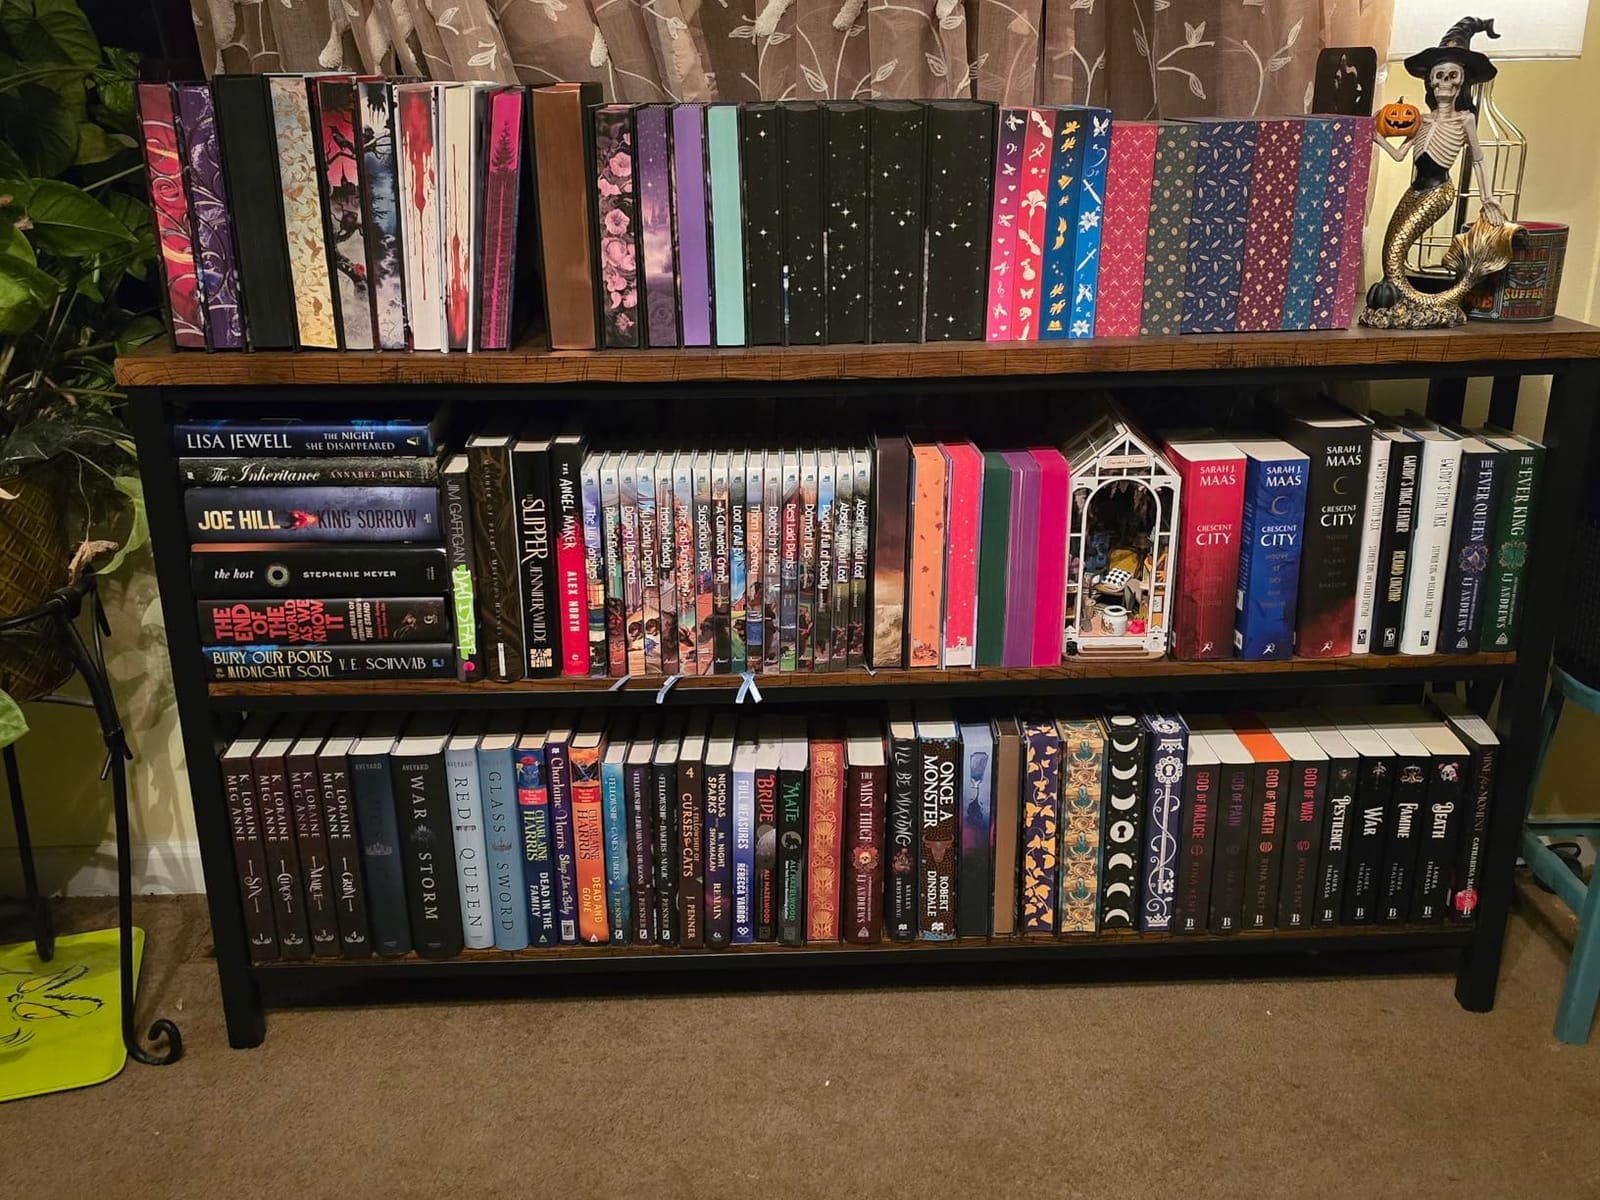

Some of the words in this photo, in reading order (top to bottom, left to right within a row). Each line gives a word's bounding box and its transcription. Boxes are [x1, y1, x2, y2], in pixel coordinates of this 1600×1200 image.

[186, 434, 224, 448] LISA
[230, 434, 292, 448] JEWELL
[306, 442, 324, 450] SHE
[326, 442, 395, 450] DISAPPEARED
[341, 432, 375, 440] NIGHT
[1327, 446, 1352, 454] SARAH
[206, 469, 228, 482] The
[232, 464, 320, 482] Inheritance
[1200, 465, 1225, 475] SARAH
[1266, 466, 1291, 476] SARAH
[1326, 454, 1362, 467] MAAS
[445, 480, 460, 499] JIM
[1200, 474, 1236, 486] MAAS
[1266, 474, 1301, 487] MAAS
[1476, 469, 1492, 500] EVER
[1513, 468, 1533, 504] EVER
[559, 478, 575, 512] ANGEL
[1321, 505, 1356, 513] CRESCENT
[198, 511, 233, 530] JOE
[238, 511, 280, 530] HILL
[318, 511, 351, 528] KING
[358, 510, 416, 528] SORROW
[585, 509, 595, 524] The
[661, 507, 671, 536] Herbal
[733, 506, 743, 525] Loot
[768, 506, 778, 536] Rooted
[786, 504, 795, 521] Best
[804, 504, 815, 540] Dormant
[838, 502, 849, 532] Absent
[855, 499, 866, 528] Absent
[1320, 512, 1356, 526] CITY
[1470, 504, 1488, 540] QUEEN
[1510, 507, 1528, 536] KING
[448, 504, 464, 562] GAFFIGAN
[520, 499, 548, 565] SLIPPER
[562, 515, 576, 550] MAKER
[697, 505, 709, 550] Suspicious
[716, 516, 725, 555] Cultivated
[733, 526, 743, 535] of
[734, 536, 744, 546] All
[786, 523, 795, 542] Laid
[821, 535, 830, 548] Full
[1196, 524, 1232, 532] CRESCENT
[1196, 532, 1232, 545] CITY
[1261, 534, 1296, 546] CITY
[1262, 526, 1296, 534] CRESCENT
[588, 543, 601, 579] Vanishes
[608, 541, 617, 576] Evidence
[625, 542, 635, 552] Up
[661, 537, 673, 568] Malady
[700, 551, 710, 571] Plots
[749, 542, 761, 574] Secrecy
[769, 548, 777, 573] Malice
[785, 544, 794, 569] Plants
[821, 550, 830, 558] of
[214, 570, 230, 578] the
[234, 570, 254, 578] host
[567, 571, 578, 595] ALEX
[717, 557, 726, 581] Crime
[818, 560, 830, 589] Deadly
[854, 562, 865, 578] Leaf
[529, 560, 545, 612] JENNIFER
[285, 600, 299, 642] WORLD
[296, 600, 313, 622] WE
[310, 600, 327, 643] KNOW
[568, 601, 580, 632] NORTH
[1457, 590, 1471, 633] ANDREWS
[1496, 585, 1512, 629] ANDREWS
[214, 608, 232, 638] THE
[232, 604, 252, 642] END
[252, 612, 270, 634] OF
[266, 606, 288, 638] THE
[300, 625, 313, 642] AS
[325, 614, 344, 630] IT
[533, 611, 546, 643] WILDE
[213, 651, 250, 664] BURY
[252, 651, 284, 664] OUR
[288, 650, 332, 664] BONES
[228, 666, 291, 678] MIDNIGHT
[296, 666, 334, 678] SOIL
[227, 775, 238, 801] MEG
[291, 772, 301, 798] MEG
[550, 757, 563, 809] Charlaine
[738, 780, 749, 800] FULL
[924, 755, 937, 828] MONSTER
[940, 762, 954, 804] ONCE
[1196, 772, 1209, 791] GOD
[1265, 769, 1279, 788] GOD
[1304, 768, 1317, 786] GOD
[259, 775, 269, 801] MEG
[264, 808, 276, 842] ANNE
[322, 773, 332, 799] MEG
[327, 805, 339, 839] ANNE
[410, 776, 427, 819] WAR
[454, 778, 471, 819] RED
[488, 771, 506, 833] GLASS
[708, 777, 716, 814] SPARKS
[757, 775, 774, 822] BRIDE
[783, 783, 800, 822] MATE
[860, 781, 873, 808] MIST
[1266, 791, 1275, 799] OF
[1304, 790, 1313, 798] OF
[232, 808, 245, 842] ANNE
[242, 792, 257, 841] LORAINE
[274, 792, 288, 841] LORAINE
[295, 805, 308, 839] ANNE
[305, 789, 320, 838] LORAINE
[337, 789, 351, 839] LORAINE
[682, 793, 692, 836] CURSES
[941, 810, 953, 821] A
[1192, 805, 1205, 839] MALICE
[1261, 802, 1275, 834] WRATH
[1300, 801, 1314, 821] WAR
[1330, 795, 1351, 851] PESTILENCE
[1363, 806, 1383, 836] WAR
[1397, 803, 1419, 839] FAMINE
[1432, 802, 1455, 839] DEATH
[524, 810, 537, 861] HARRIS
[535, 809, 547, 861] CHARLAINE
[555, 810, 567, 849] Harris
[577, 809, 590, 859] HARRIS
[589, 809, 599, 861] CHARLAINE
[738, 804, 749, 849] MEASURES
[859, 812, 873, 841] THIEF
[684, 848, 693, 877] CATS
[418, 852, 438, 920] STORM
[460, 848, 482, 927] QUEEN
[539, 872, 549, 897] DEAD
[592, 877, 601, 901] DEAD
[736, 863, 747, 895] REBECCA
[927, 871, 937, 916] DINSDALE
[939, 876, 948, 911] ROBERT
[496, 863, 514, 930] SWORD
[530, 885, 540, 917] FAMILY
[542, 900, 550, 909] IN
[561, 896, 573, 914] Baby
[583, 888, 591, 913] GONE
[713, 883, 721, 920] REMAIN
[736, 897, 746, 923] YARROS
[857, 886, 866, 923] ANDREWS
[543, 912, 552, 929] THE
[594, 903, 603, 923] AND
